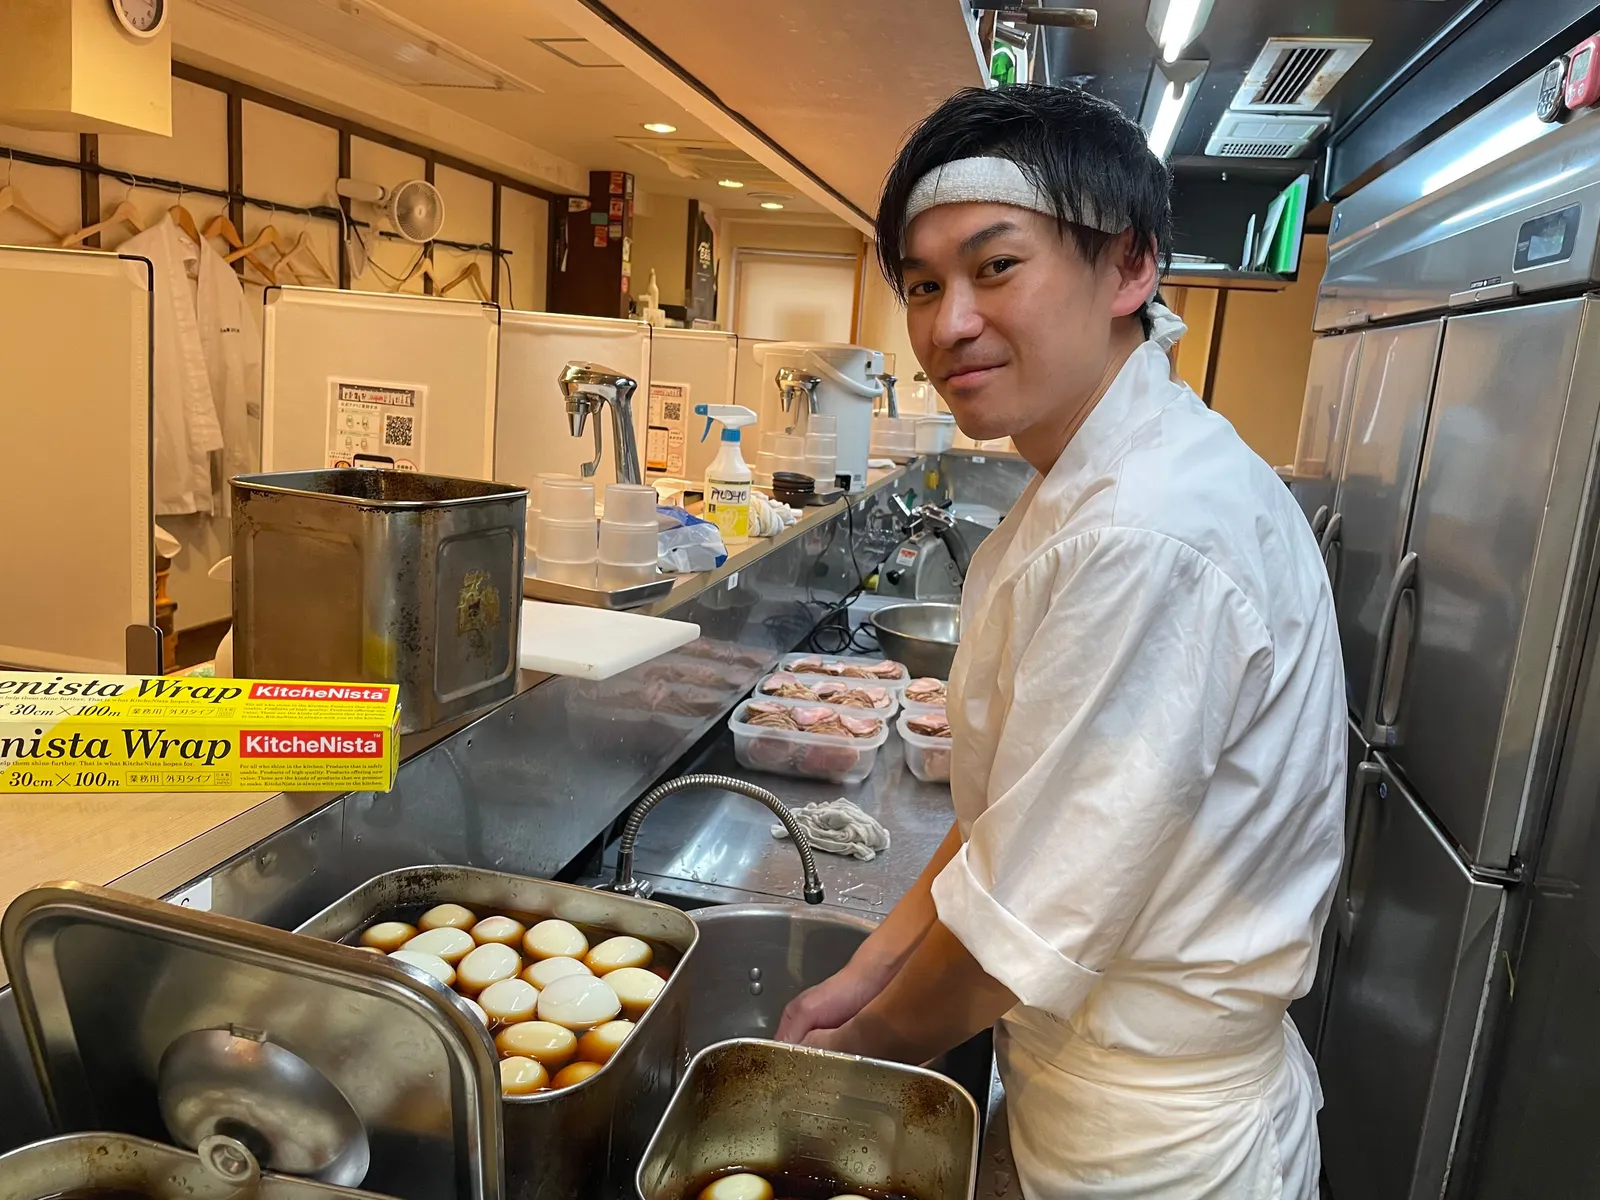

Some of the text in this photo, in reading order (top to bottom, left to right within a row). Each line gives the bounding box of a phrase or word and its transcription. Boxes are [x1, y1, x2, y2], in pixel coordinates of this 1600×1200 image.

[138, 679, 242, 703] Wrap
[255, 685, 384, 700] KitcheNista
[0, 728, 231, 766] nista Wrap
[246, 735, 377, 753] KitcheNista
